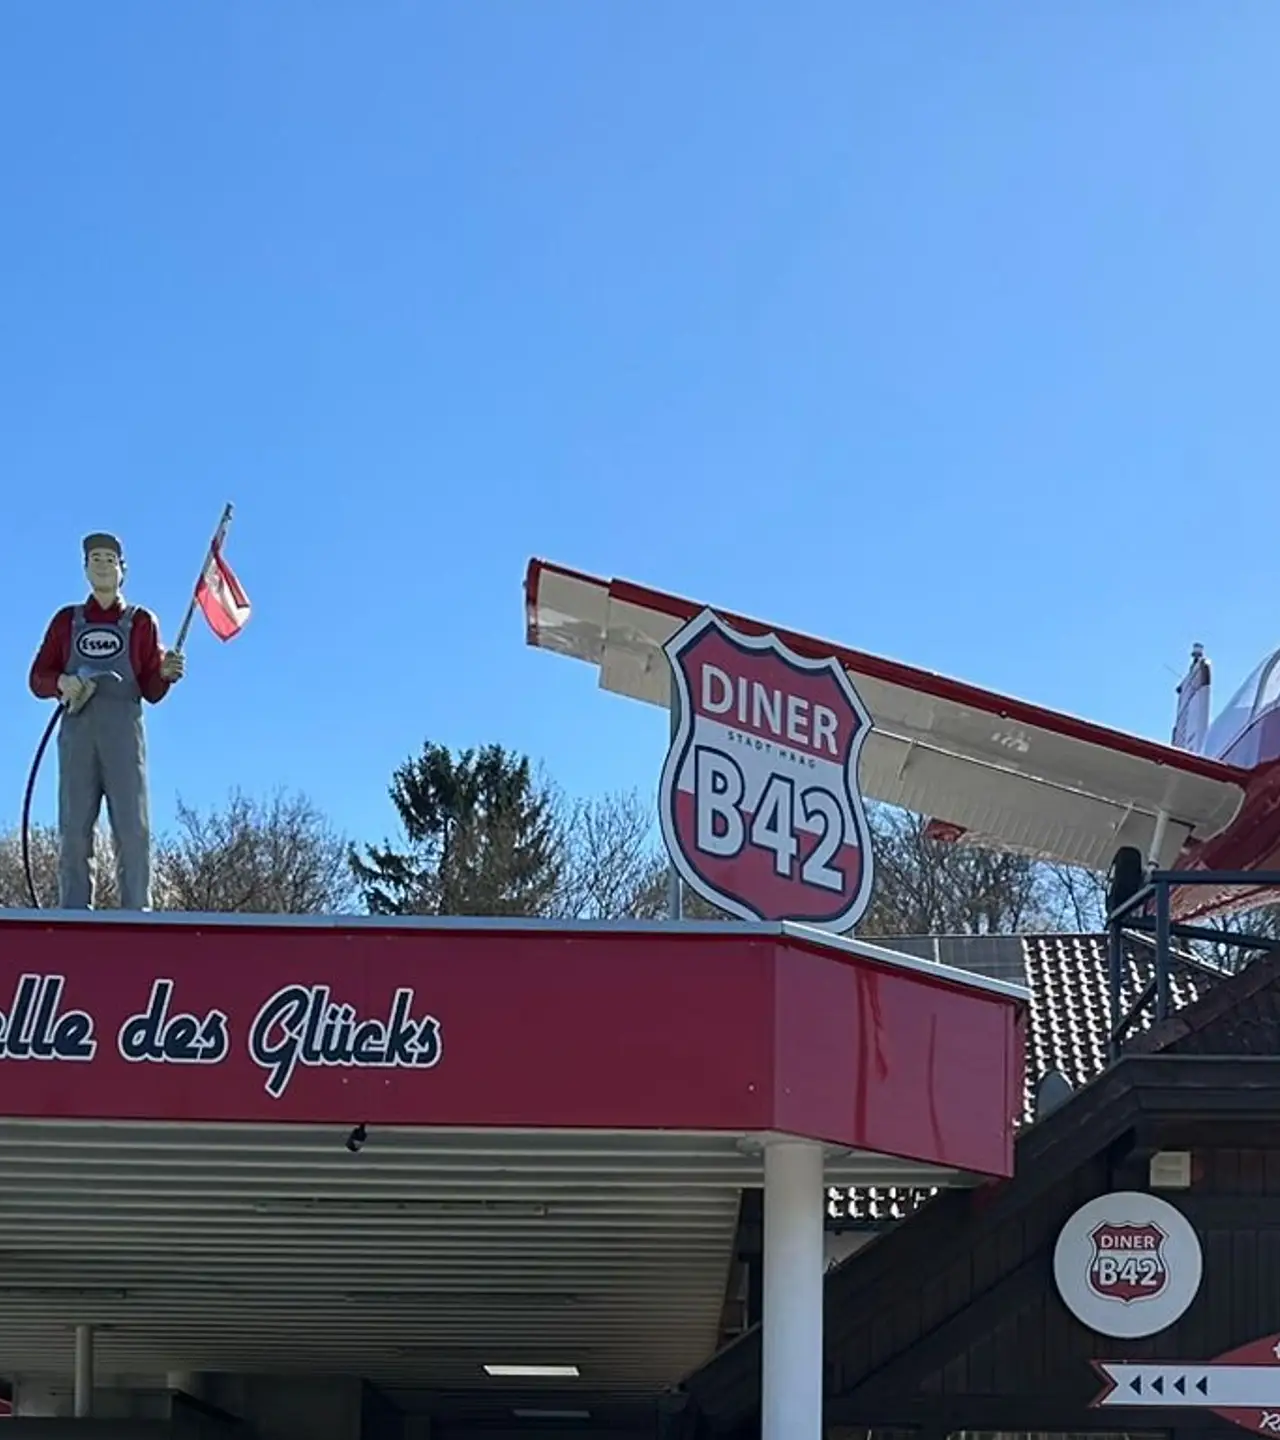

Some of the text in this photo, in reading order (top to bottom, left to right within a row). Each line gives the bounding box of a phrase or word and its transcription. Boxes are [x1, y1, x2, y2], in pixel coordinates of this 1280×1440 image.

[701, 663, 839, 756] DINER
[727, 730, 817, 769] STADT HAAG
[694, 744, 847, 896] B42
[119, 979, 229, 1064] des
[248, 985, 442, 1098] Glücks
[1098, 1256, 1158, 1287] B42
[1100, 1235, 1155, 1249] DINER
